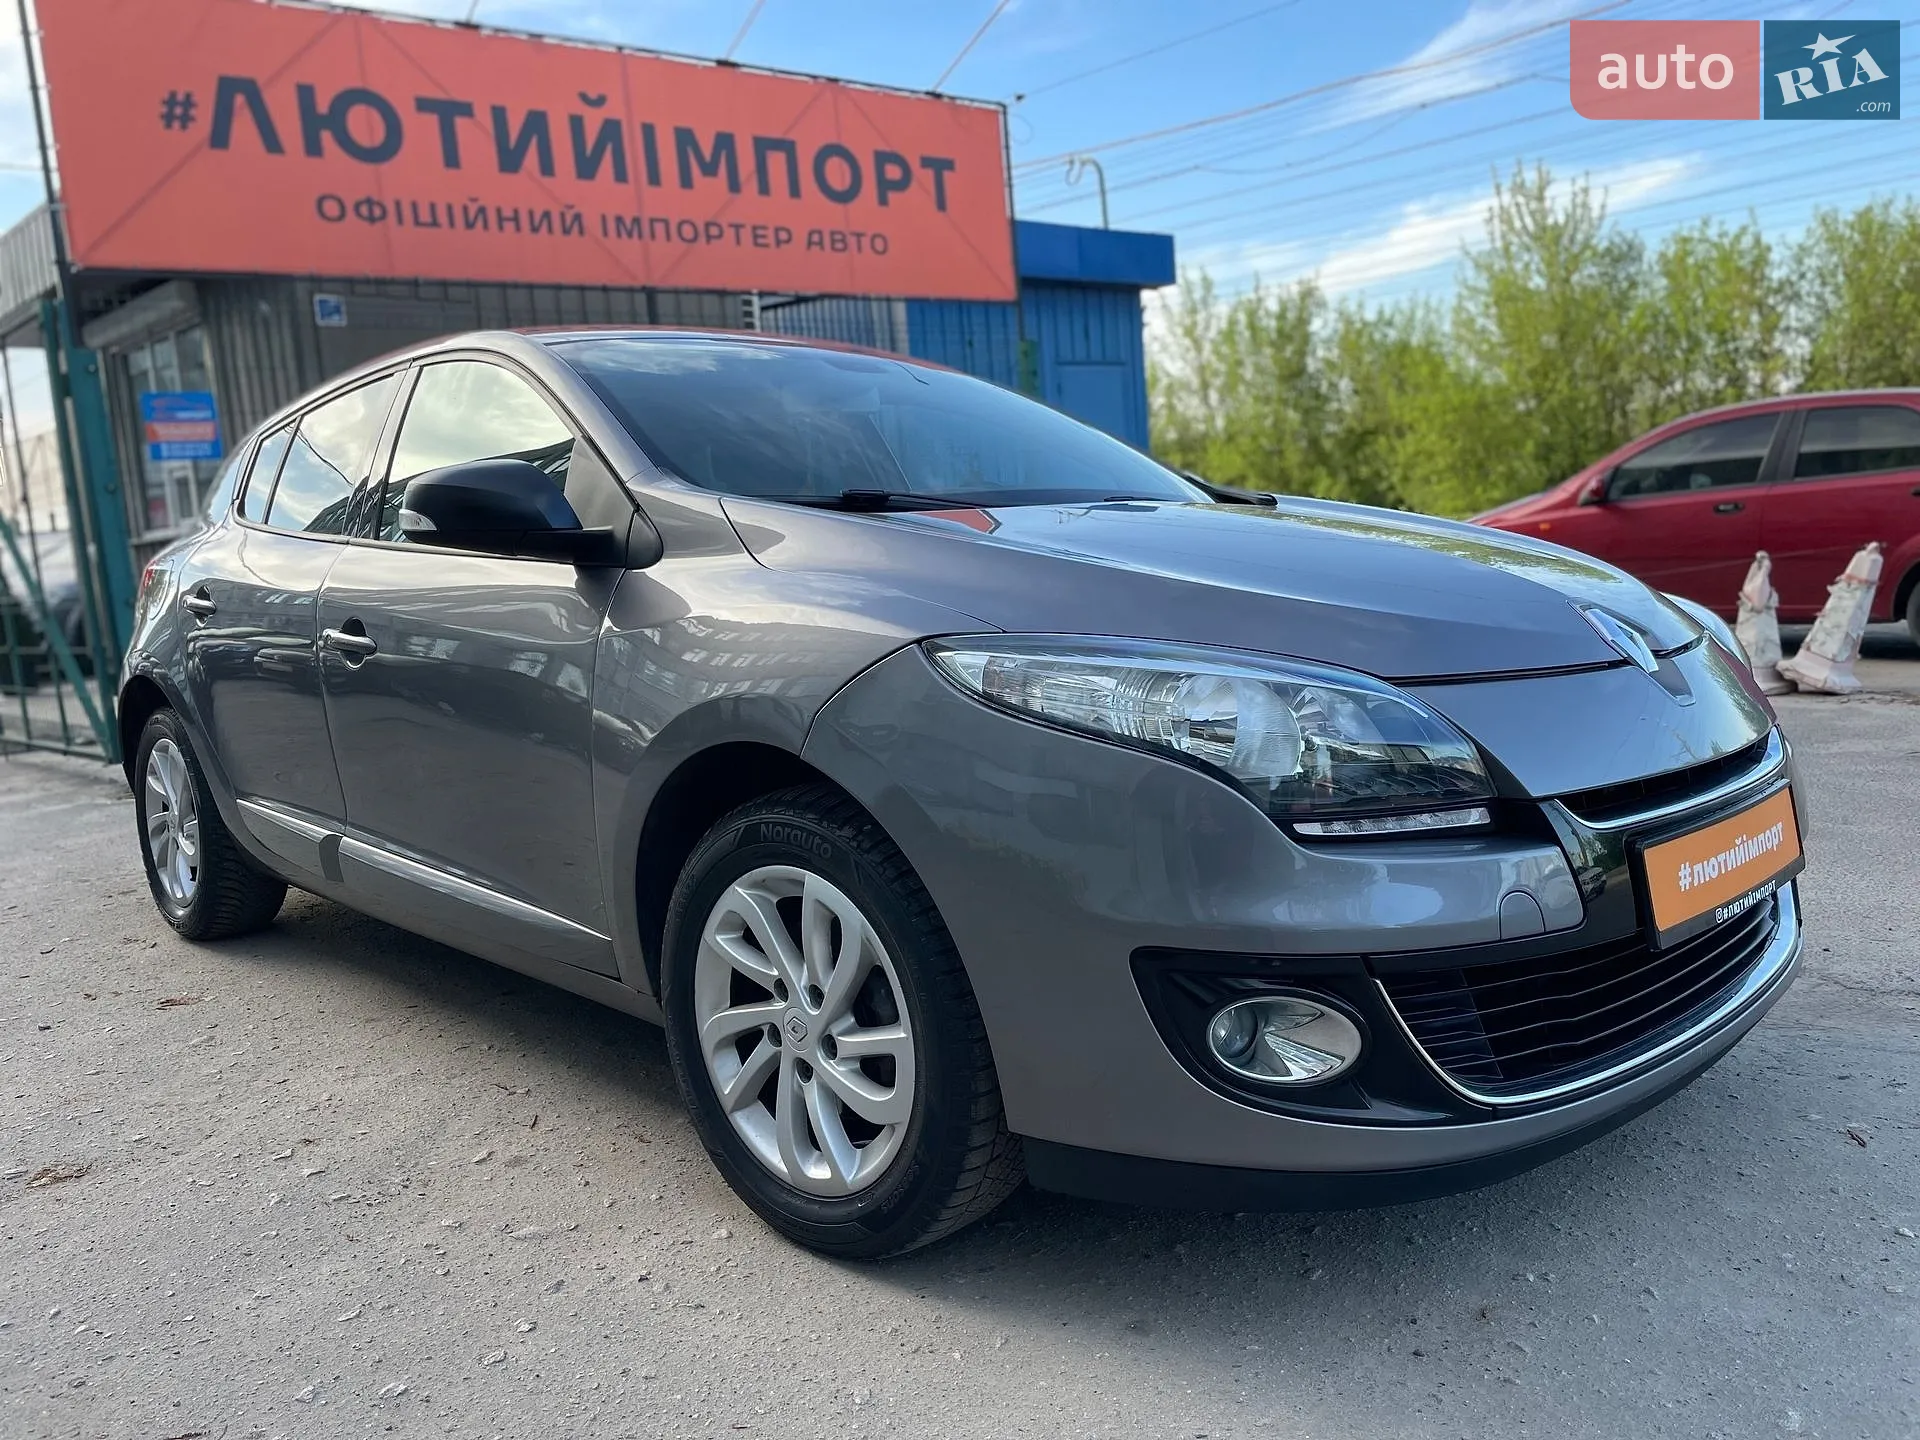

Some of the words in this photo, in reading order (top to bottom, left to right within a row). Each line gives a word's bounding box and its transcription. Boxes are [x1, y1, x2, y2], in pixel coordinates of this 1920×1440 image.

[159, 75, 956, 213] #ЛЮТИЙІМПОРТ
[601, 213, 793, 249] ІМПОРТЕР
[806, 231, 890, 256] АВТО
[760, 823, 832, 859] Norauto
[1678, 821, 1783, 892] #лютийімпорт
